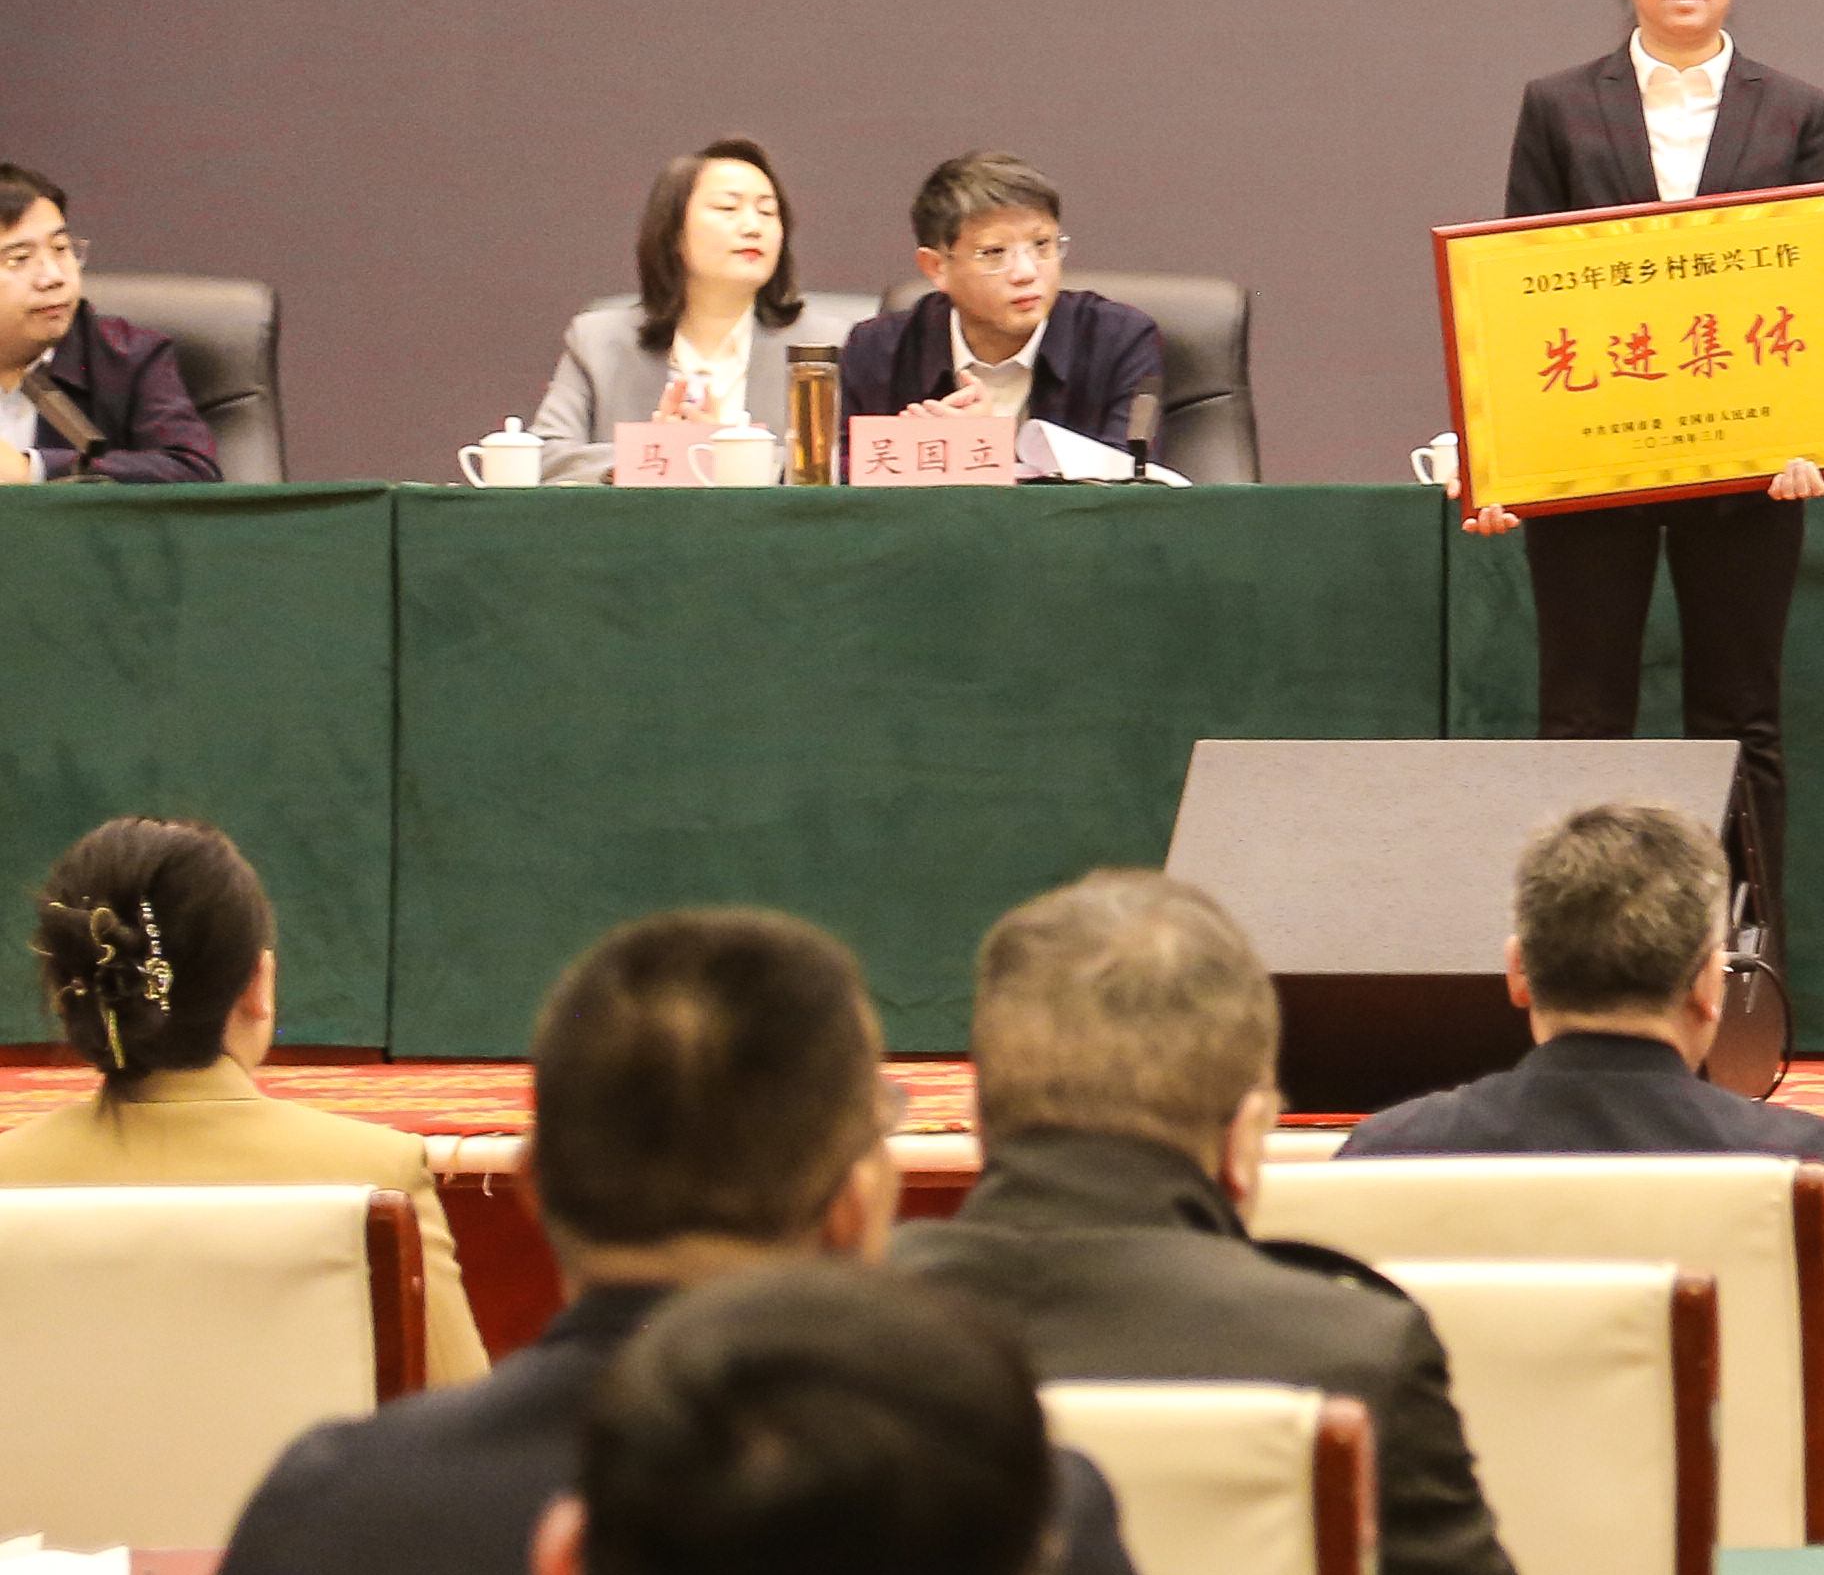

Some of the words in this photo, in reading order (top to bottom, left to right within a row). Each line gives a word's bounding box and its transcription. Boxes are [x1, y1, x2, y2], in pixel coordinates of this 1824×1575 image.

[1523, 243, 1802, 295] 2023年度乡村振兴工作
[1537, 306, 1807, 393] 先进集体
[864, 438, 1001, 475] 吴国立
